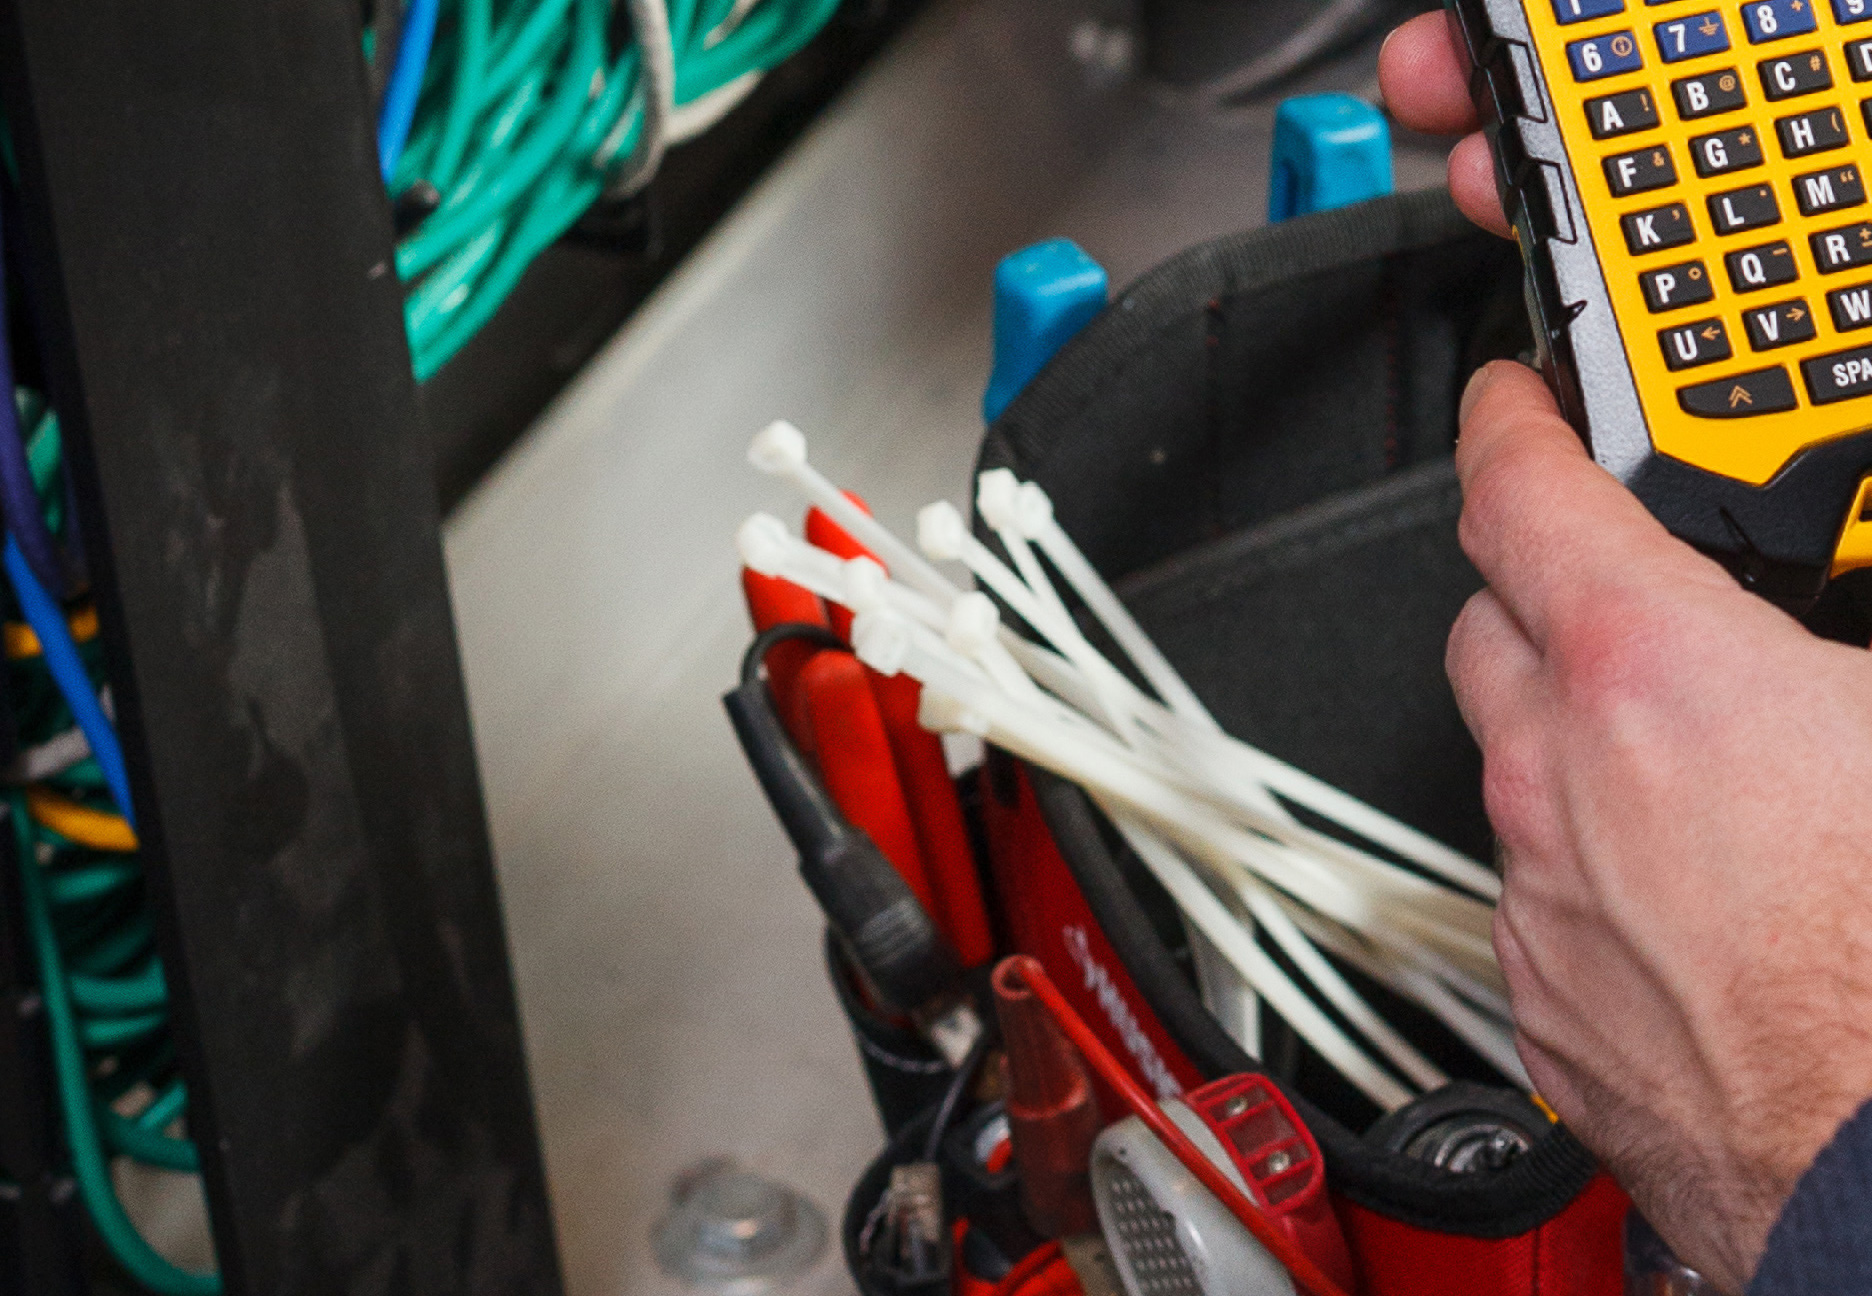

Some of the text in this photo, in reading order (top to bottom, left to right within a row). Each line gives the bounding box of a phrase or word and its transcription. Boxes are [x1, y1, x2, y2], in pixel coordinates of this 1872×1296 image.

[1756, 4, 1778, 34] 8
[1667, 23, 1686, 53] 7
[1581, 42, 1603, 73] 6
[1774, 61, 1796, 91] C
[1686, 81, 1709, 111] B
[1602, 100, 1625, 131] A
[1790, 118, 1815, 149] H
[1704, 138, 1729, 168] G
[1617, 157, 1637, 188] F
[1805, 174, 1836, 208] M
[1722, 197, 1745, 226] L
[1635, 214, 1661, 246] K
[1825, 234, 1851, 265] R
[1740, 253, 1767, 284] Q
[1655, 273, 1676, 304] P
[1840, 289, 1871, 322] W
[1757, 310, 1779, 341] V
[1673, 329, 1698, 361] U
